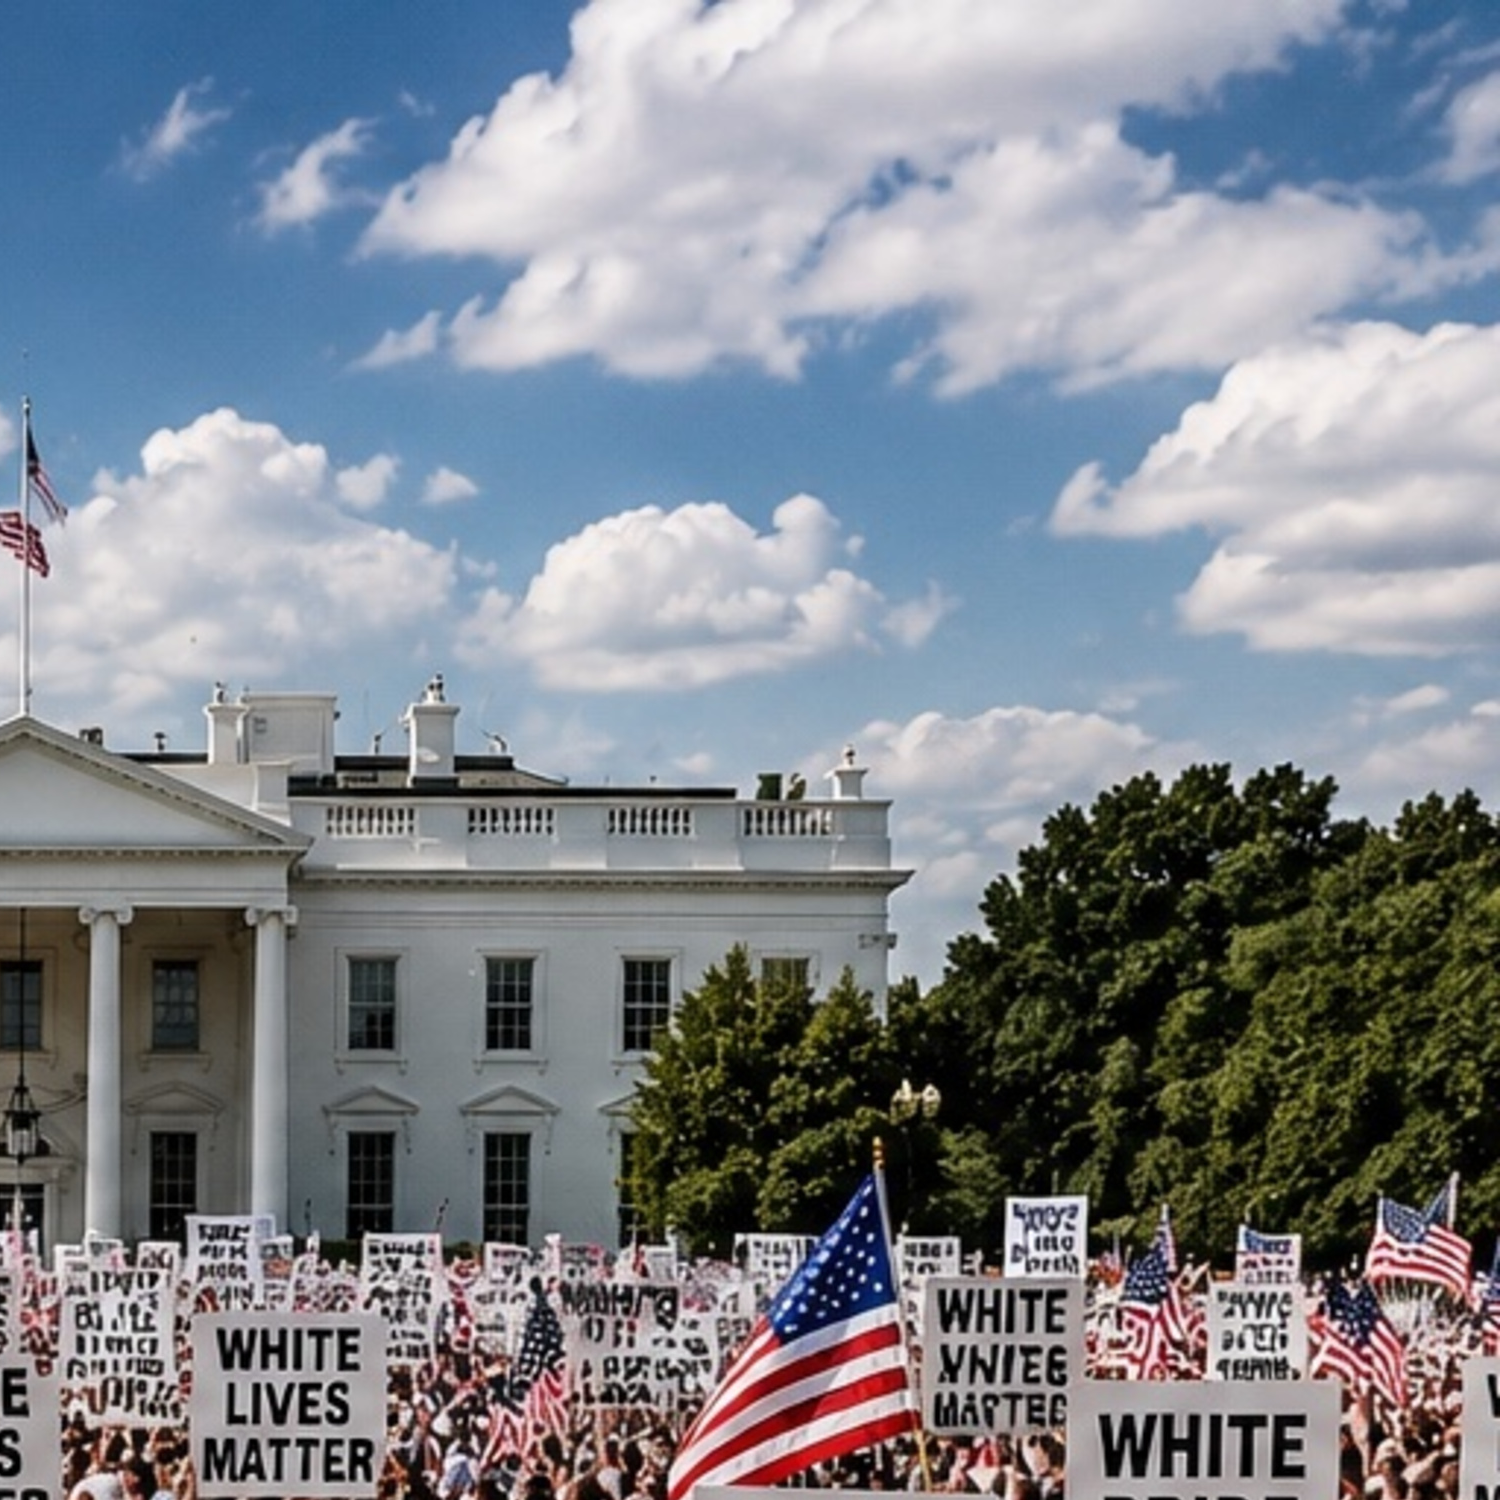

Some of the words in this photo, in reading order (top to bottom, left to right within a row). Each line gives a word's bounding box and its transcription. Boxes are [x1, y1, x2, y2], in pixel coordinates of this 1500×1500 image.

[938, 1289, 1068, 1334] WHITE
[217, 1328, 360, 1371] WHITE
[227, 1382, 349, 1426] LIVES
[203, 1438, 374, 1482] MATTER
[1099, 1414, 1306, 1478] WHITE
